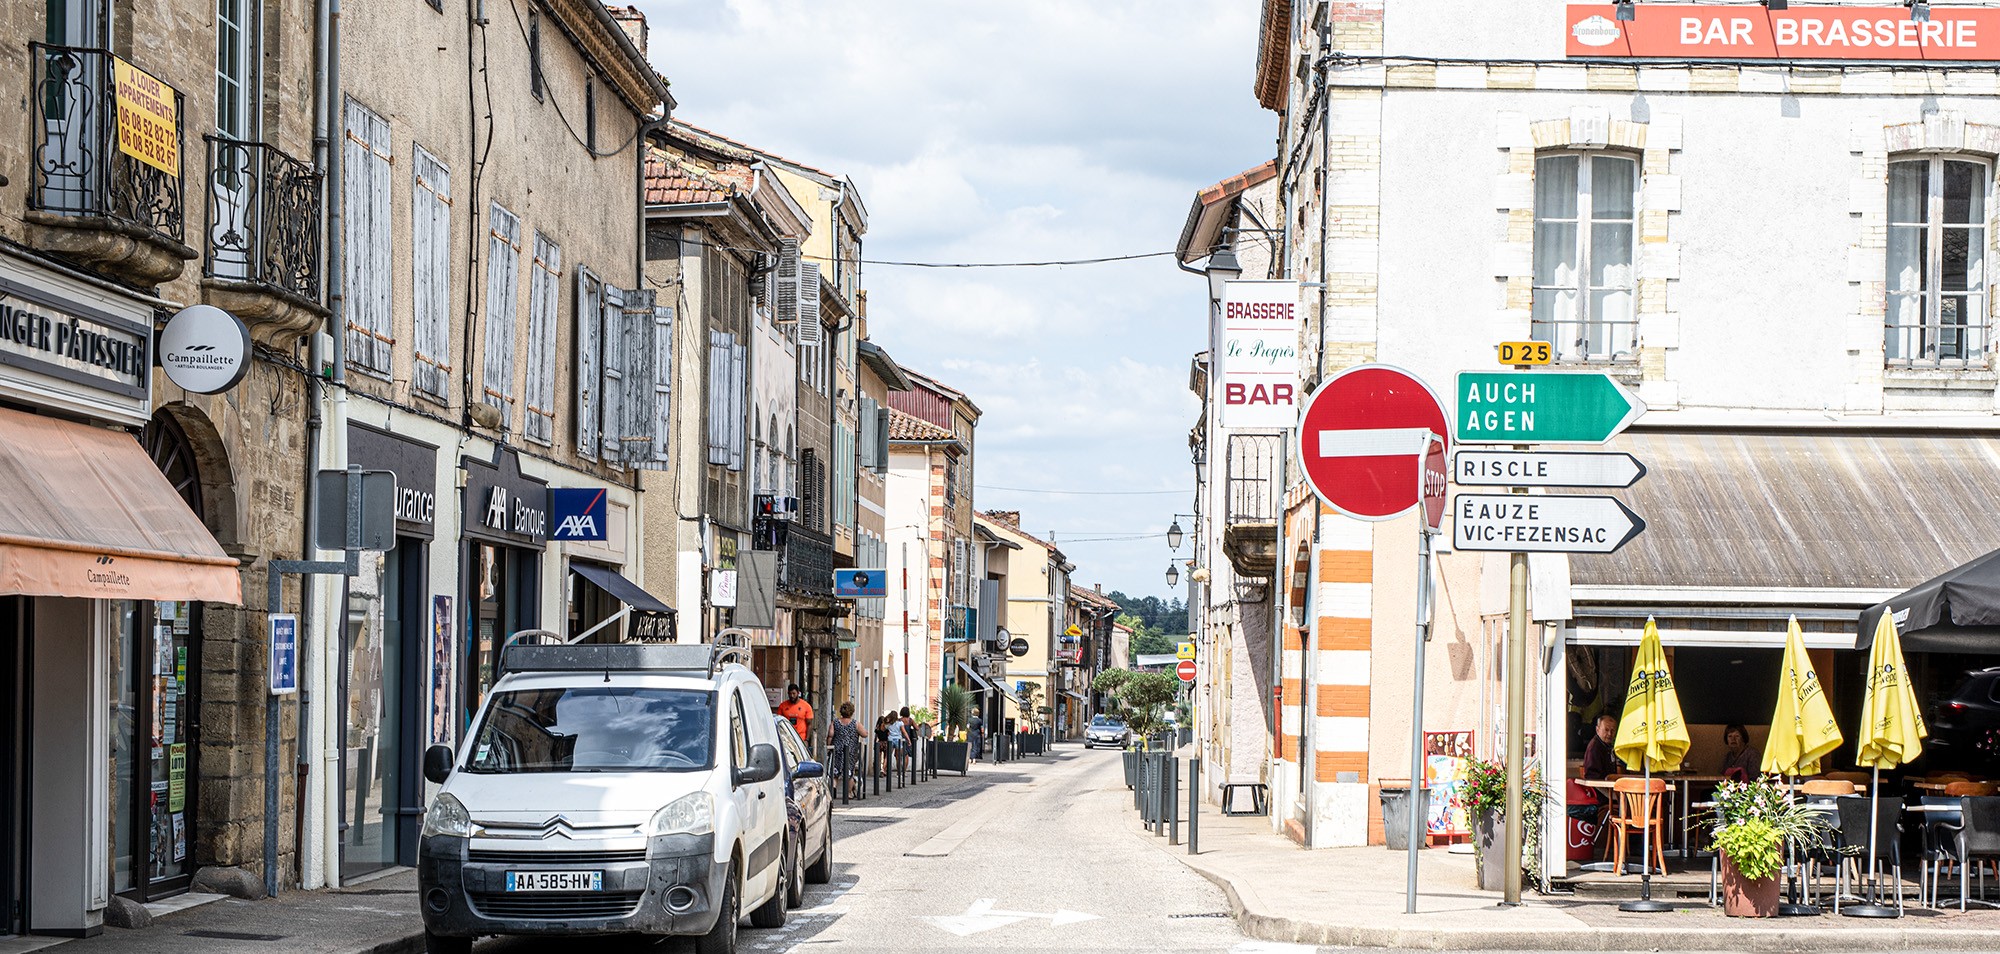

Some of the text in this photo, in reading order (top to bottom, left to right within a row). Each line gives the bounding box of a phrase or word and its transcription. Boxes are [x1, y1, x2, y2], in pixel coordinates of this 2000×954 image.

[1680, 17, 1977, 48] BAR BRASSERIE
[130, 69, 160, 98] A LOUER
[118, 81, 173, 123] APPARTEMENTS
[120, 105, 175, 149] 06 08 52 82 72
[121, 126, 175, 169] 06 08 52 82 67
[1226, 302, 1294, 320] BRASSERIE
[57, 318, 143, 388] PÂTISSIER
[167, 352, 234, 365] Campaillette
[1226, 339, 1294, 366] Le Progrès
[1502, 345, 1548, 361] D 25
[1225, 383, 1293, 405] BAR
[1467, 383, 1535, 403] AUCH
[1466, 410, 1534, 431] AGEN
[1464, 461, 1548, 477] RISCLE
[1425, 469, 1445, 498] STOP
[396, 486, 434, 523] urance
[486, 485, 545, 542] AXA Banque
[1463, 500, 1539, 520] ÉAUZE
[554, 515, 598, 537] AXA
[1463, 525, 1606, 543] VIC-FEZENSAC
[87, 569, 130, 587] Campaillette
[172, 757, 185, 770] LOTO
[516, 873, 591, 889] AA-585-HW
[593, 881, 602, 889] 61
